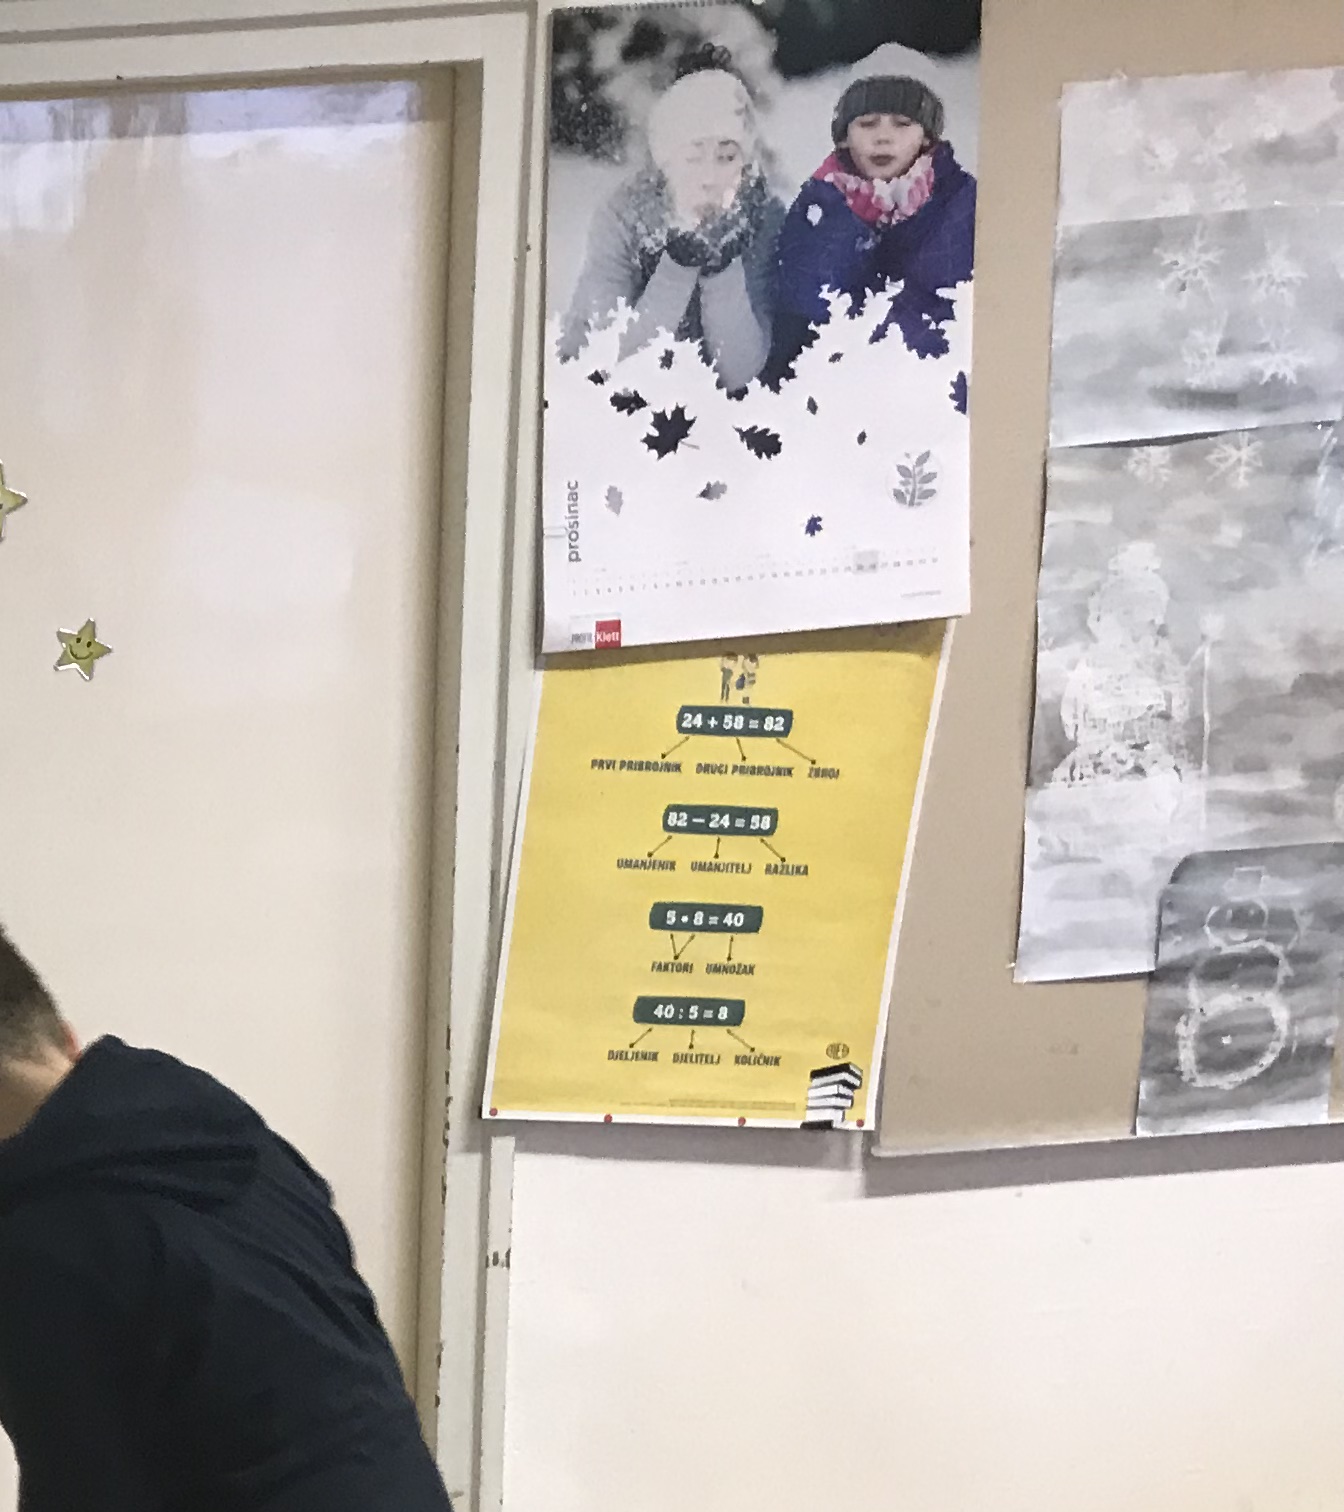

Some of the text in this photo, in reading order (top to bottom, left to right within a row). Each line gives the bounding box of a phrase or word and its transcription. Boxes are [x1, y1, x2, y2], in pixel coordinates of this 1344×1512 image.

[565, 480, 581, 562] prosinac
[682, 713, 703, 729] 24
[723, 714, 744, 730] 58
[764, 715, 785, 731] 82
[591, 759, 616, 771] PRVI
[667, 811, 688, 827] 82
[709, 813, 730, 828] 24
[617, 858, 676, 872] UMANJENIK
[666, 910, 676, 925] 5
[693, 911, 704, 926] 8
[723, 912, 744, 927] 40
[653, 1003, 675, 1019] 40
